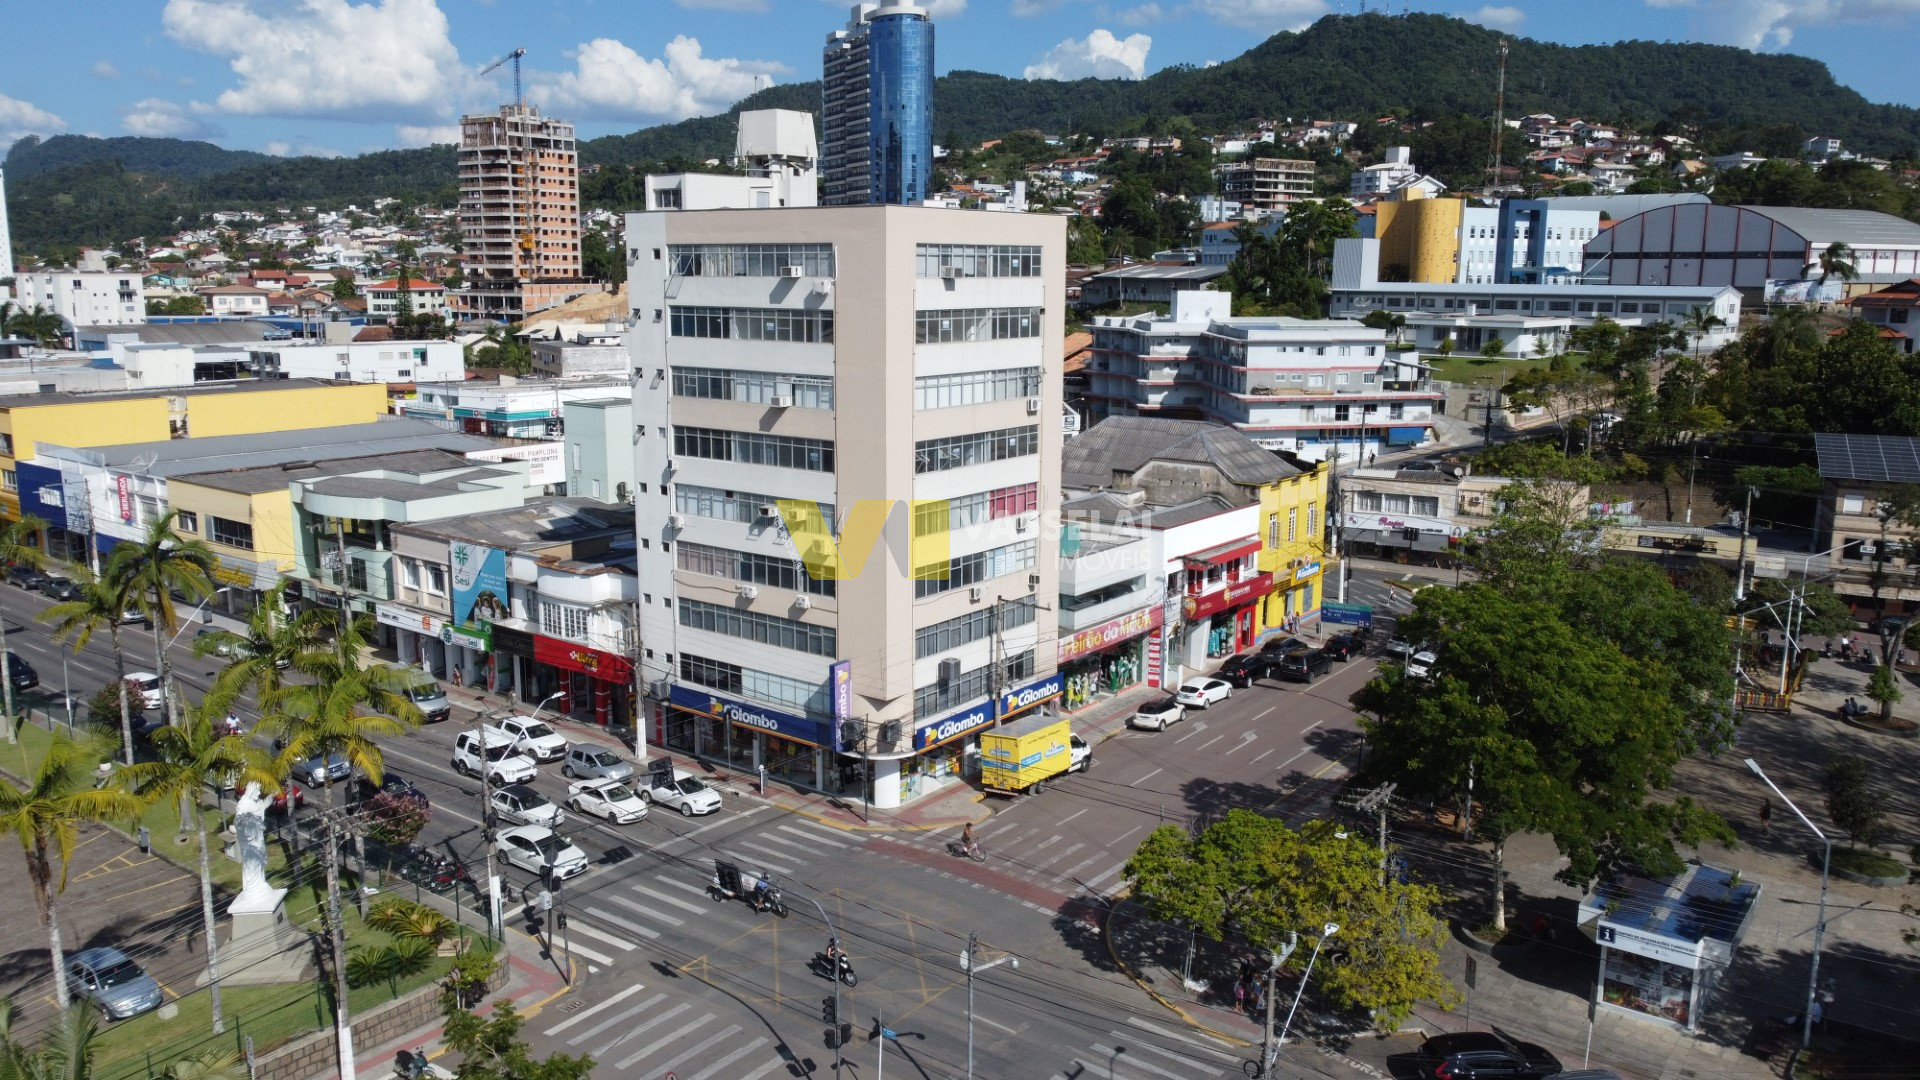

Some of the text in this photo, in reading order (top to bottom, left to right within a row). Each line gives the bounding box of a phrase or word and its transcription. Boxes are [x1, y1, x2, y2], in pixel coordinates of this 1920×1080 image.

[527, 448, 558, 458] PAMPLONA
[120, 477, 129, 510] BERLANDA
[454, 575, 470, 586] Sesi
[1064, 630, 1102, 656] Feirão
[1103, 625, 1118, 642] da
[1017, 682, 1059, 707] Colombo
[937, 712, 984, 740] Colombo
[1617, 930, 1634, 938] CENTRO
